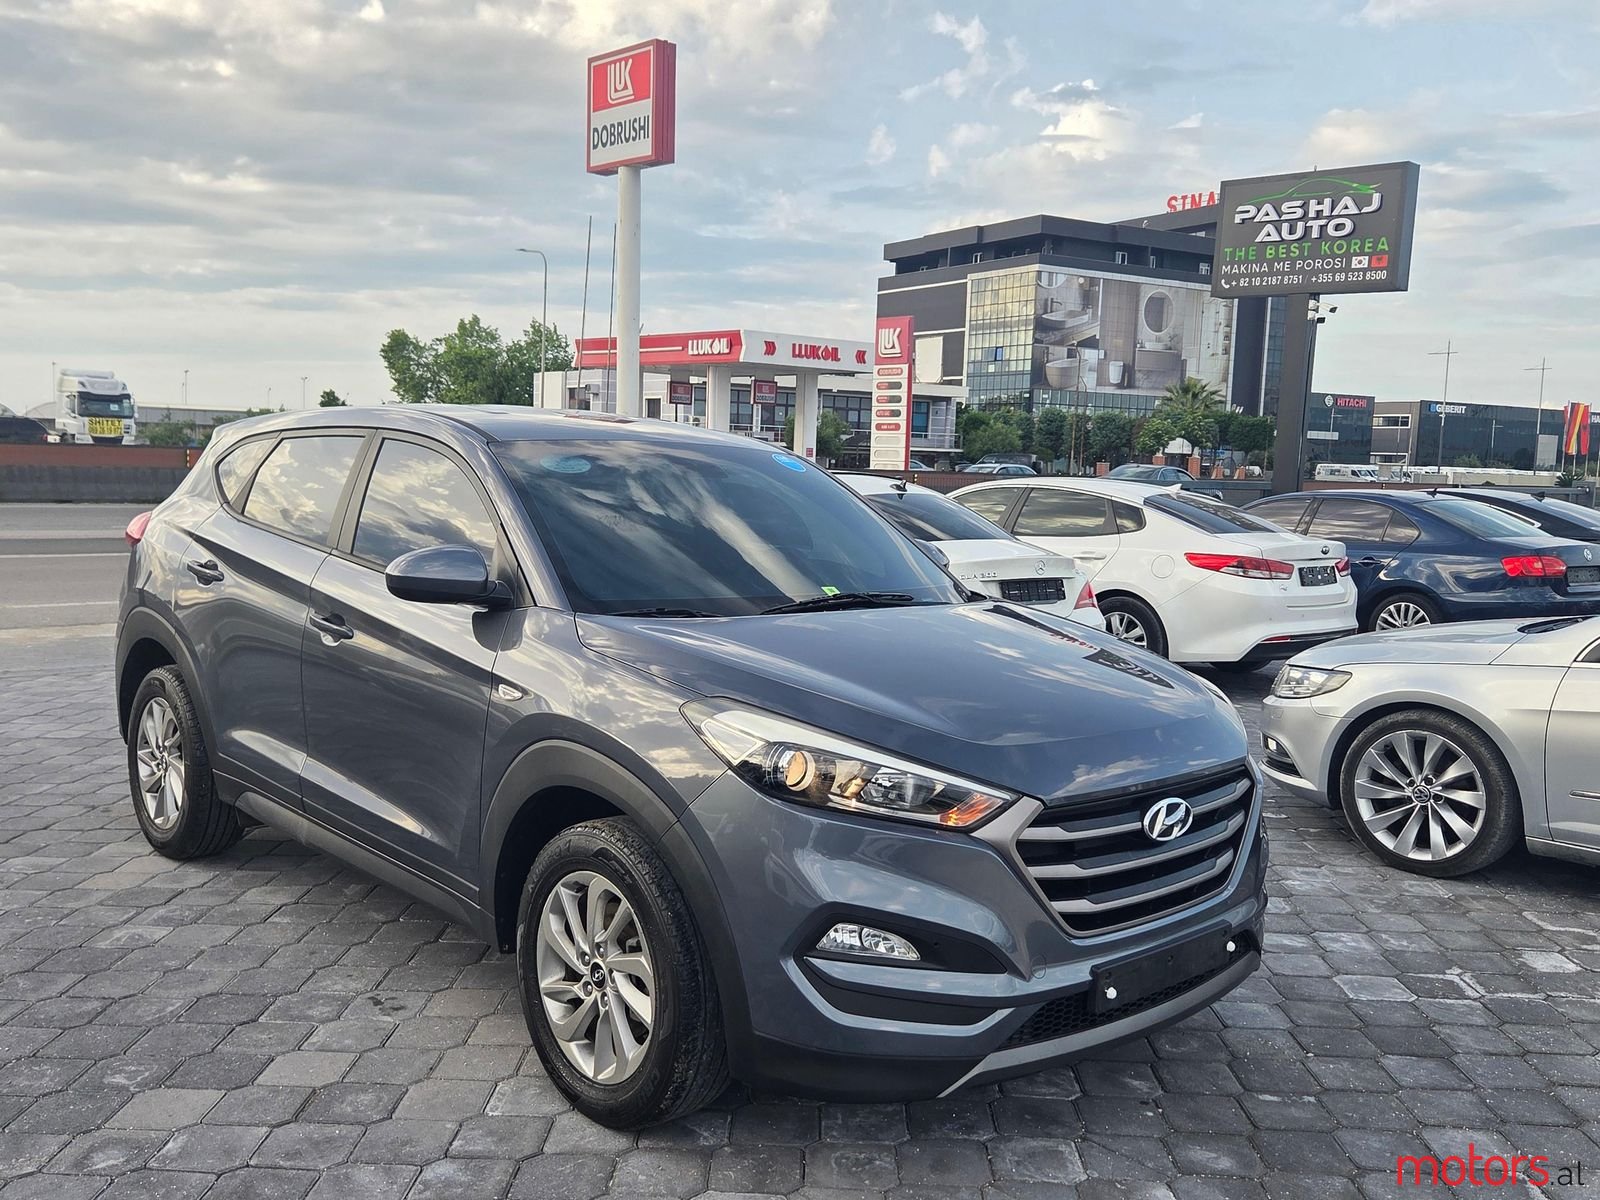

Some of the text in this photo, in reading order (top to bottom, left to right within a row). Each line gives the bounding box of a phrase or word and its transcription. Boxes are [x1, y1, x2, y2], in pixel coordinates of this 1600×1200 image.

[592, 115, 650, 150] DOBRUSHI
[1234, 192, 1382, 224] PASHAJ
[1255, 217, 1354, 243] AUTO
[1224, 237, 1389, 261] THE BEST KOREA
[1221, 257, 1346, 275] MAKINA ME POROSI
[1251, 277, 1260, 286] 10
[1262, 276, 1282, 286] 2187
[1283, 274, 1303, 285] 8751
[1311, 272, 1333, 283] +355
[1335, 272, 1346, 282] 69
[1347, 271, 1364, 281] 523
[1365, 270, 1387, 280] 8500
[1336, 398, 1367, 408] HITACHI
